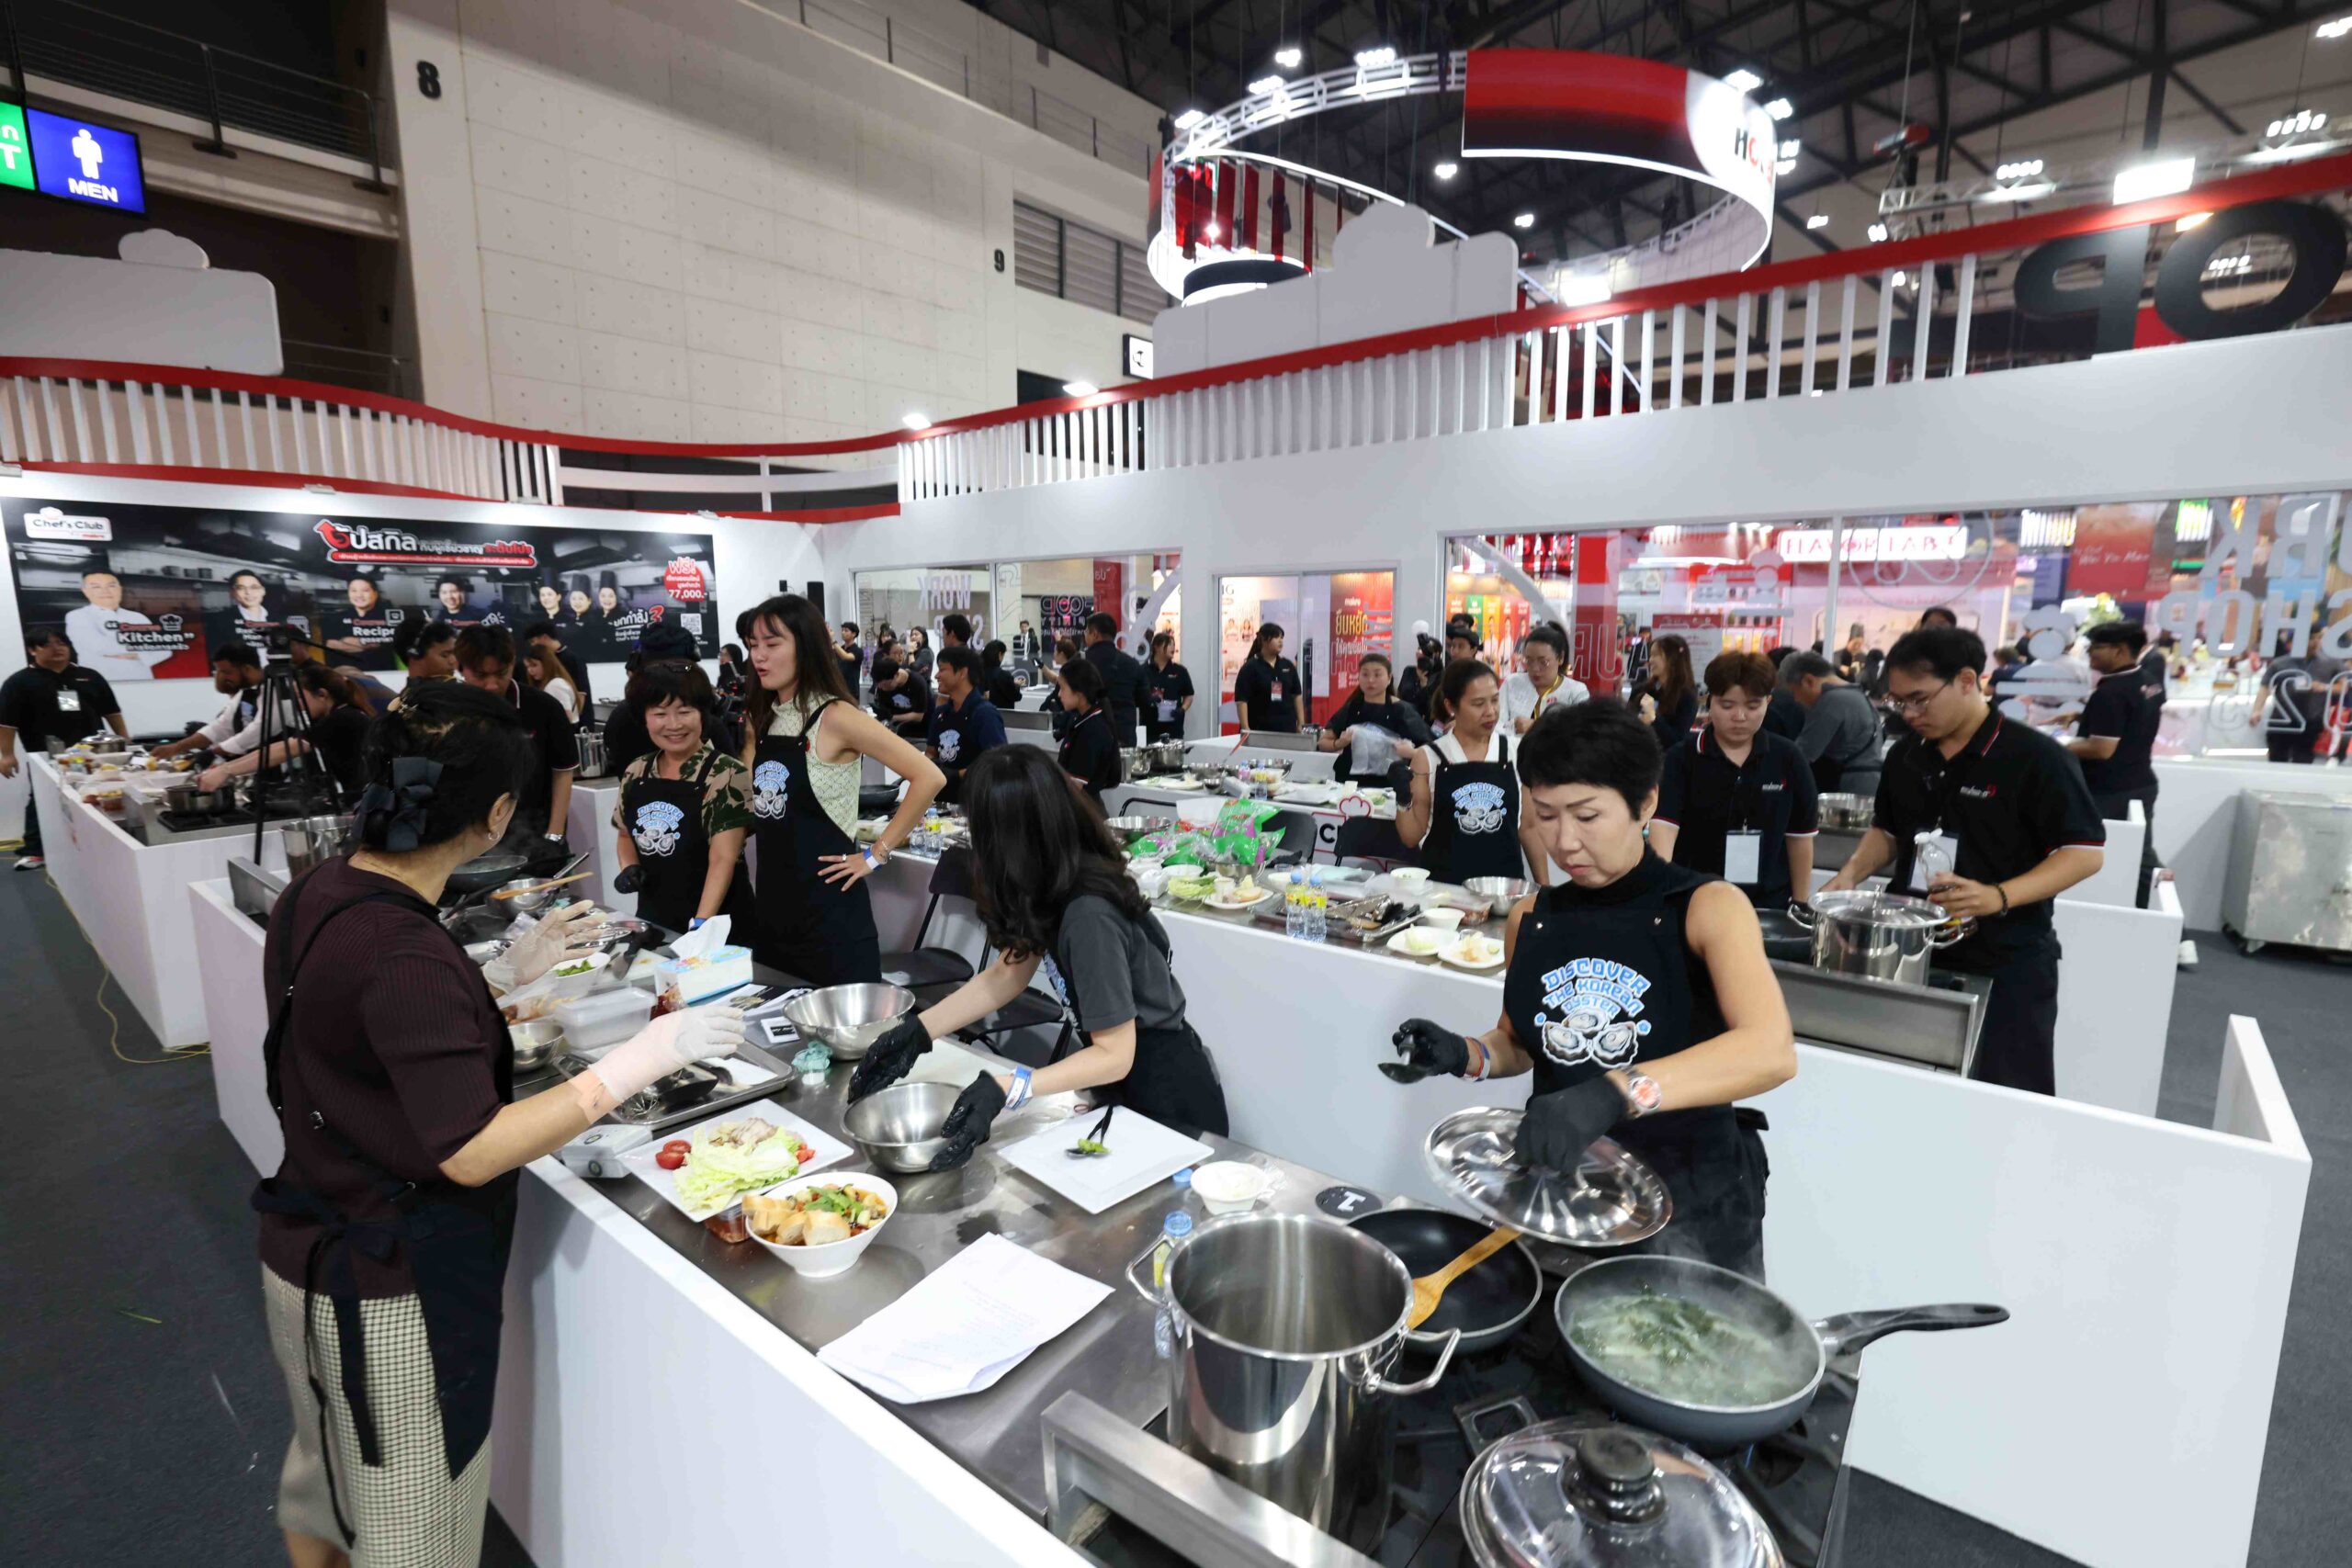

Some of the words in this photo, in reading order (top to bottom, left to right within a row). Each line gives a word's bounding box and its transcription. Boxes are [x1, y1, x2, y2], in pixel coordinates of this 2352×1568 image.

[417, 62, 442, 99] 8
[68, 177, 119, 203] MEN
[994, 249, 1005, 273] 9
[32, 519, 72, 529] Chef's
[75, 521, 104, 530] Club
[669, 589, 707, 600] 77,000.-
[755, 760, 790, 780] DISCOVER
[1452, 782, 1505, 800] DISCOVER
[637, 801, 684, 822] DISCOVER
[1541, 957, 1652, 998] DISCOVER
[1542, 981, 1576, 1010] THE
[1576, 977, 1645, 1018] KOREAN
[1561, 994, 1622, 1021] OYSTER
